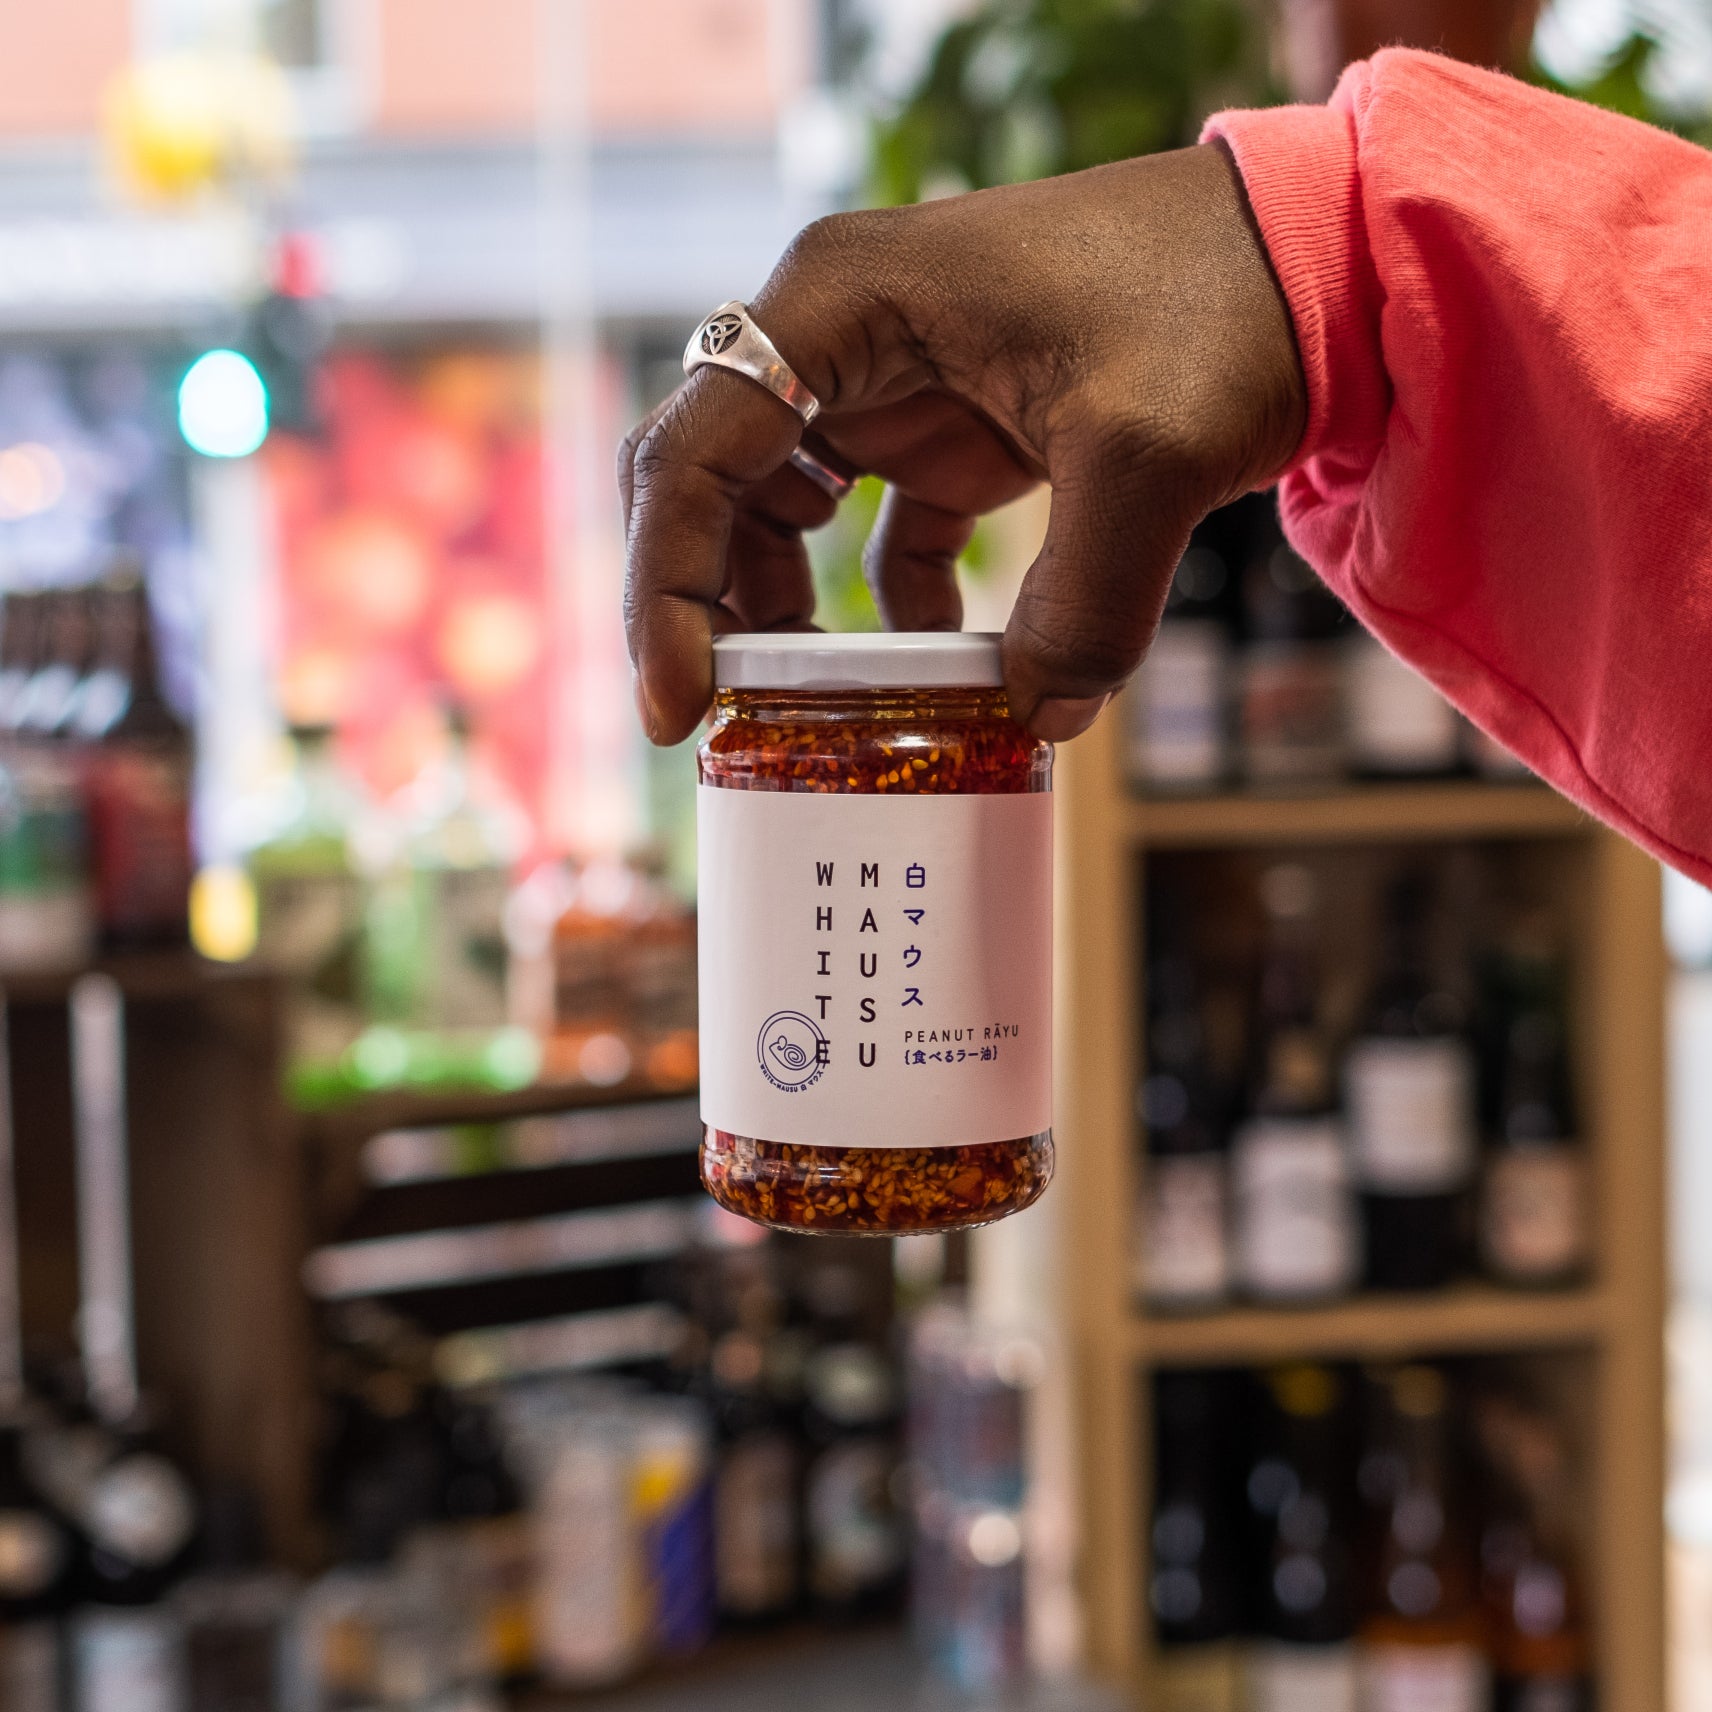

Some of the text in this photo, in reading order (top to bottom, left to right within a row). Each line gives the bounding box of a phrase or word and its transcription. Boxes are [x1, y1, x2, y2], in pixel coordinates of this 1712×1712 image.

[815, 861, 834, 1065] WHITE
[859, 862, 879, 1068] MAUSU
[901, 862, 926, 1007] 白マウス
[904, 1023, 1019, 1043] PEANUT RĀYU
